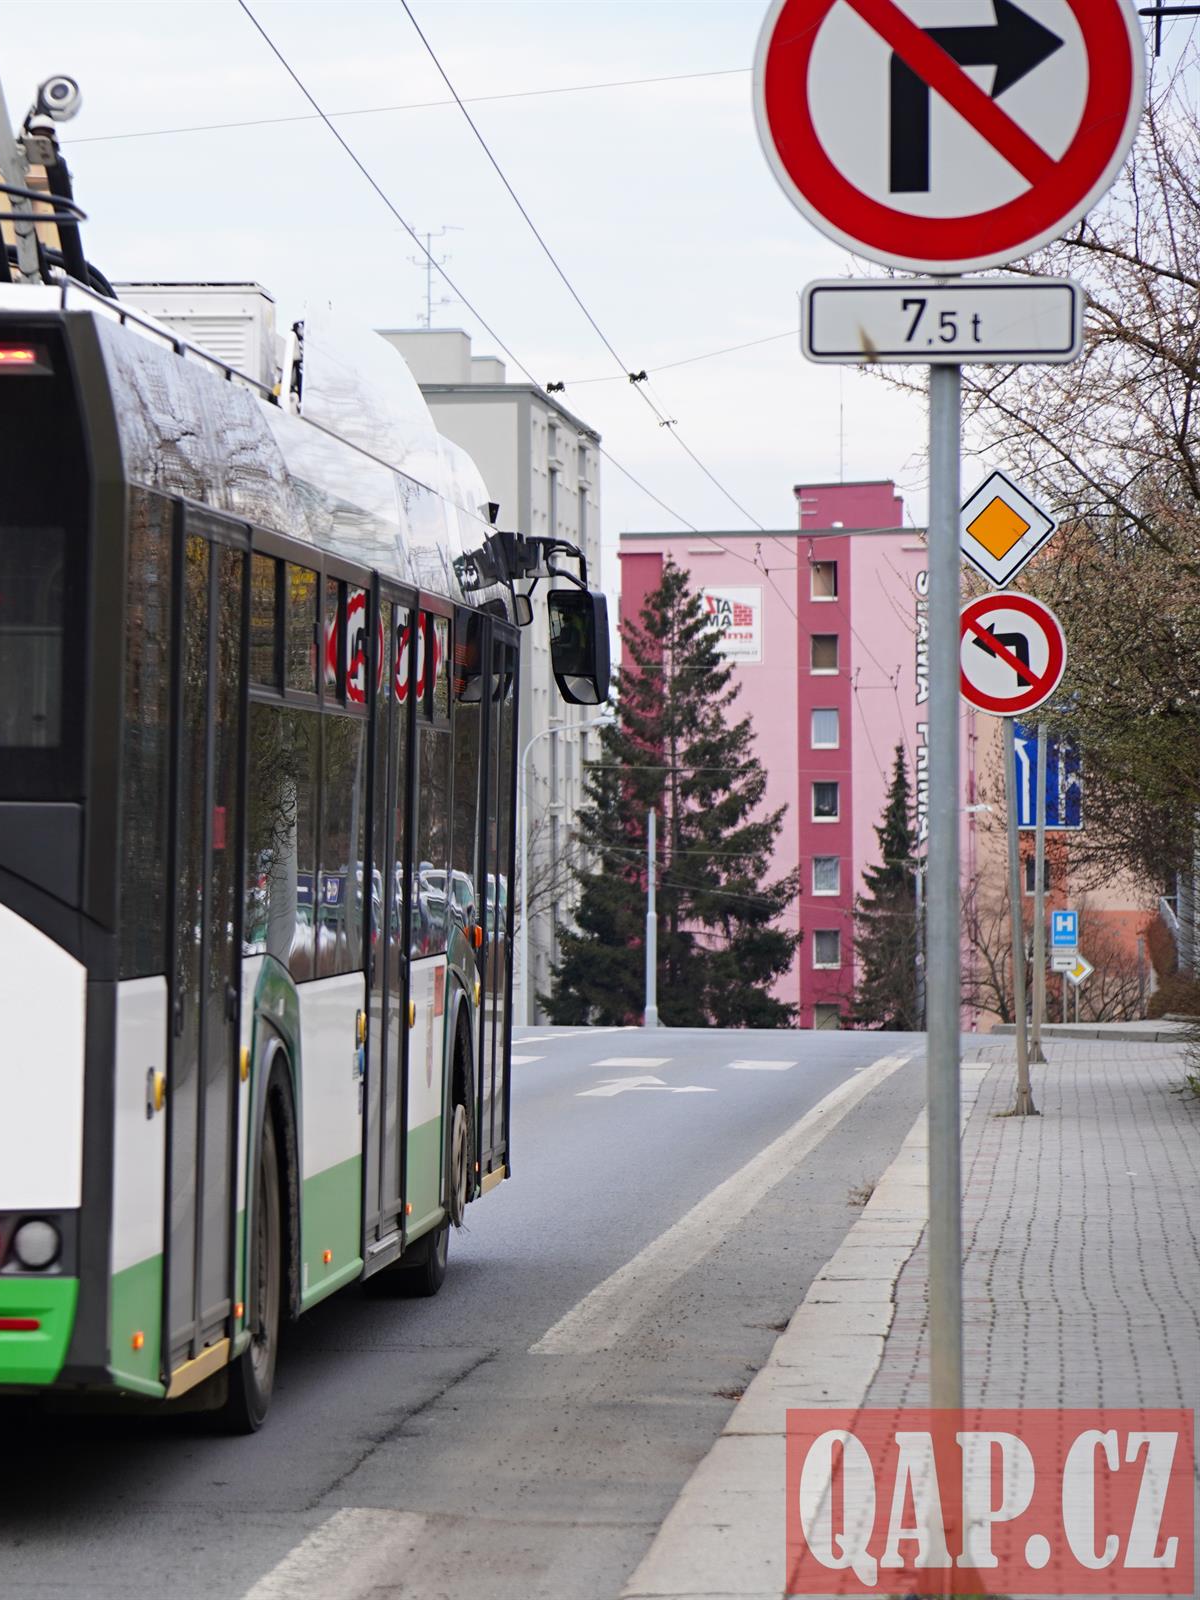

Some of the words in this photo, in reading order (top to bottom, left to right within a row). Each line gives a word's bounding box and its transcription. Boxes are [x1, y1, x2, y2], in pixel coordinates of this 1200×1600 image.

[901, 298, 958, 346] 7,5
[971, 312, 982, 343] t
[1056, 915, 1074, 932] H
